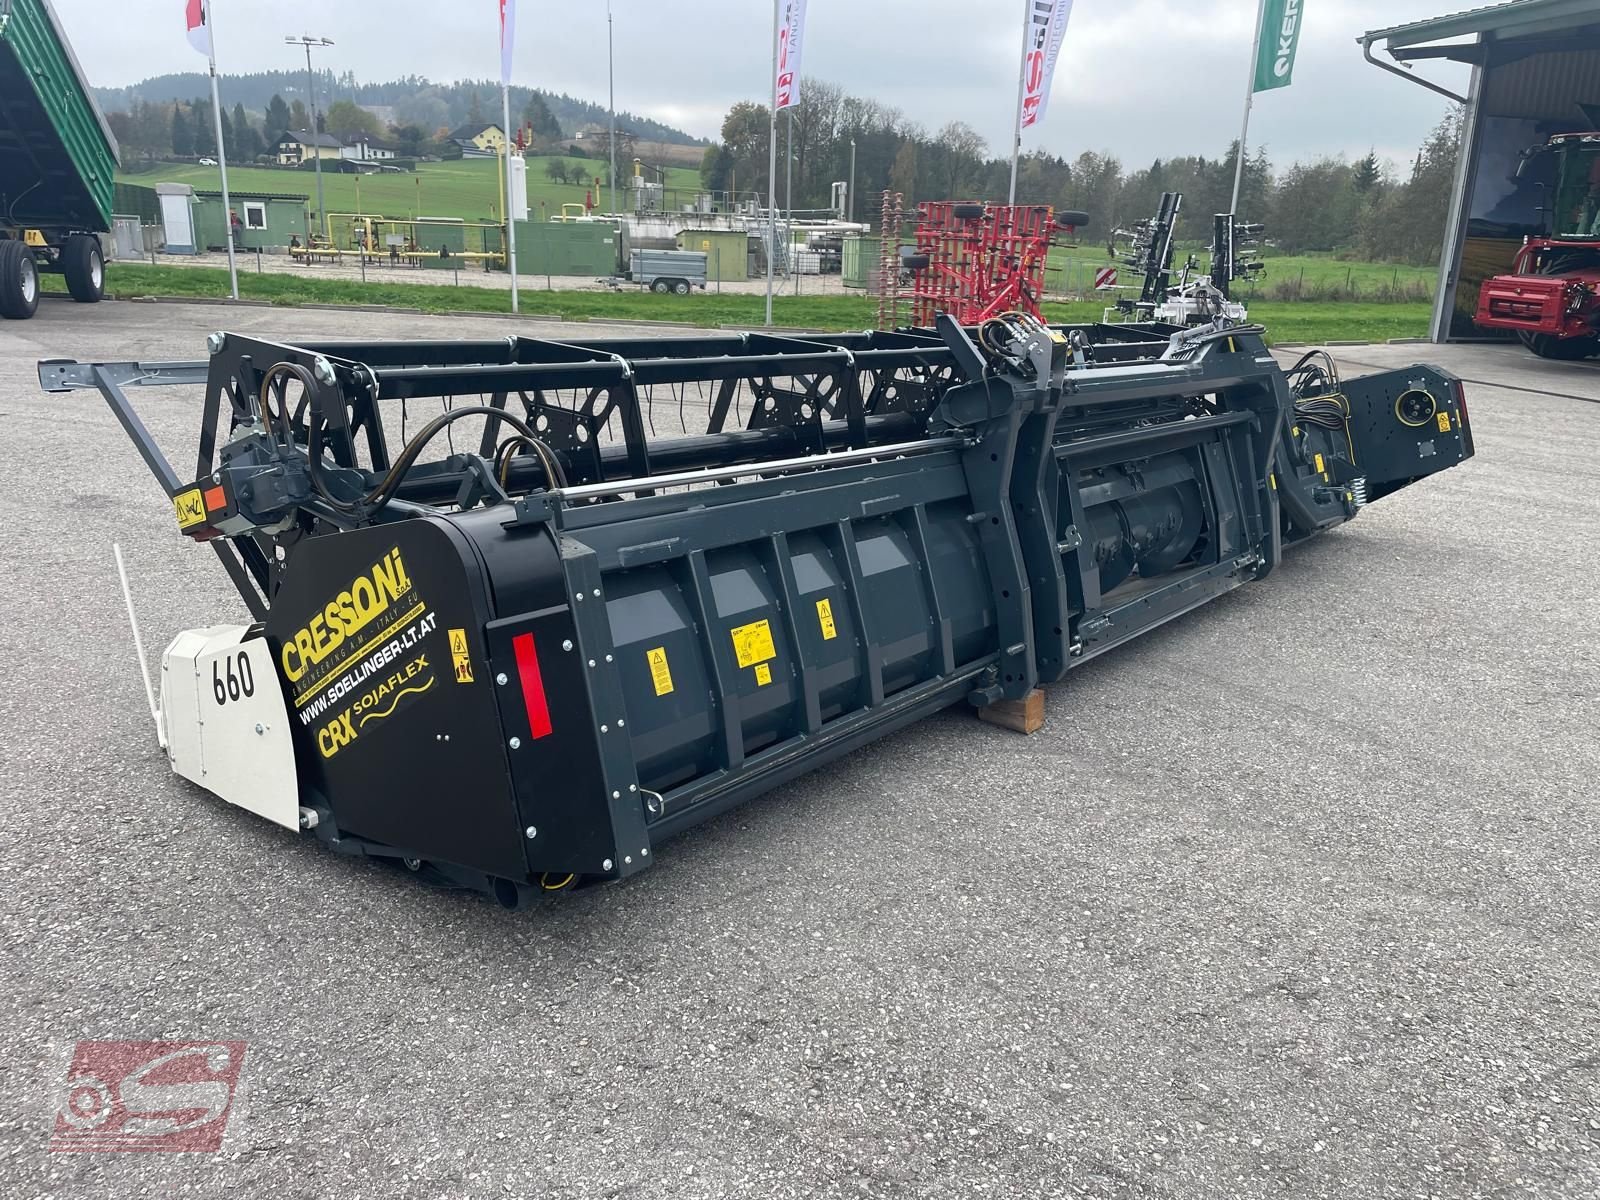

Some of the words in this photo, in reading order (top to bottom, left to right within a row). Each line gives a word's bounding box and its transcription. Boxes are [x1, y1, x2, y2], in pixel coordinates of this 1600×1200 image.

[376, 608, 400, 630] ITALY
[212, 650, 255, 706] 660
[299, 612, 438, 726] WWW.SOELLINGER-LT.AT
[318, 710, 358, 759] CRX
[353, 653, 430, 715] SOJAFLEX
